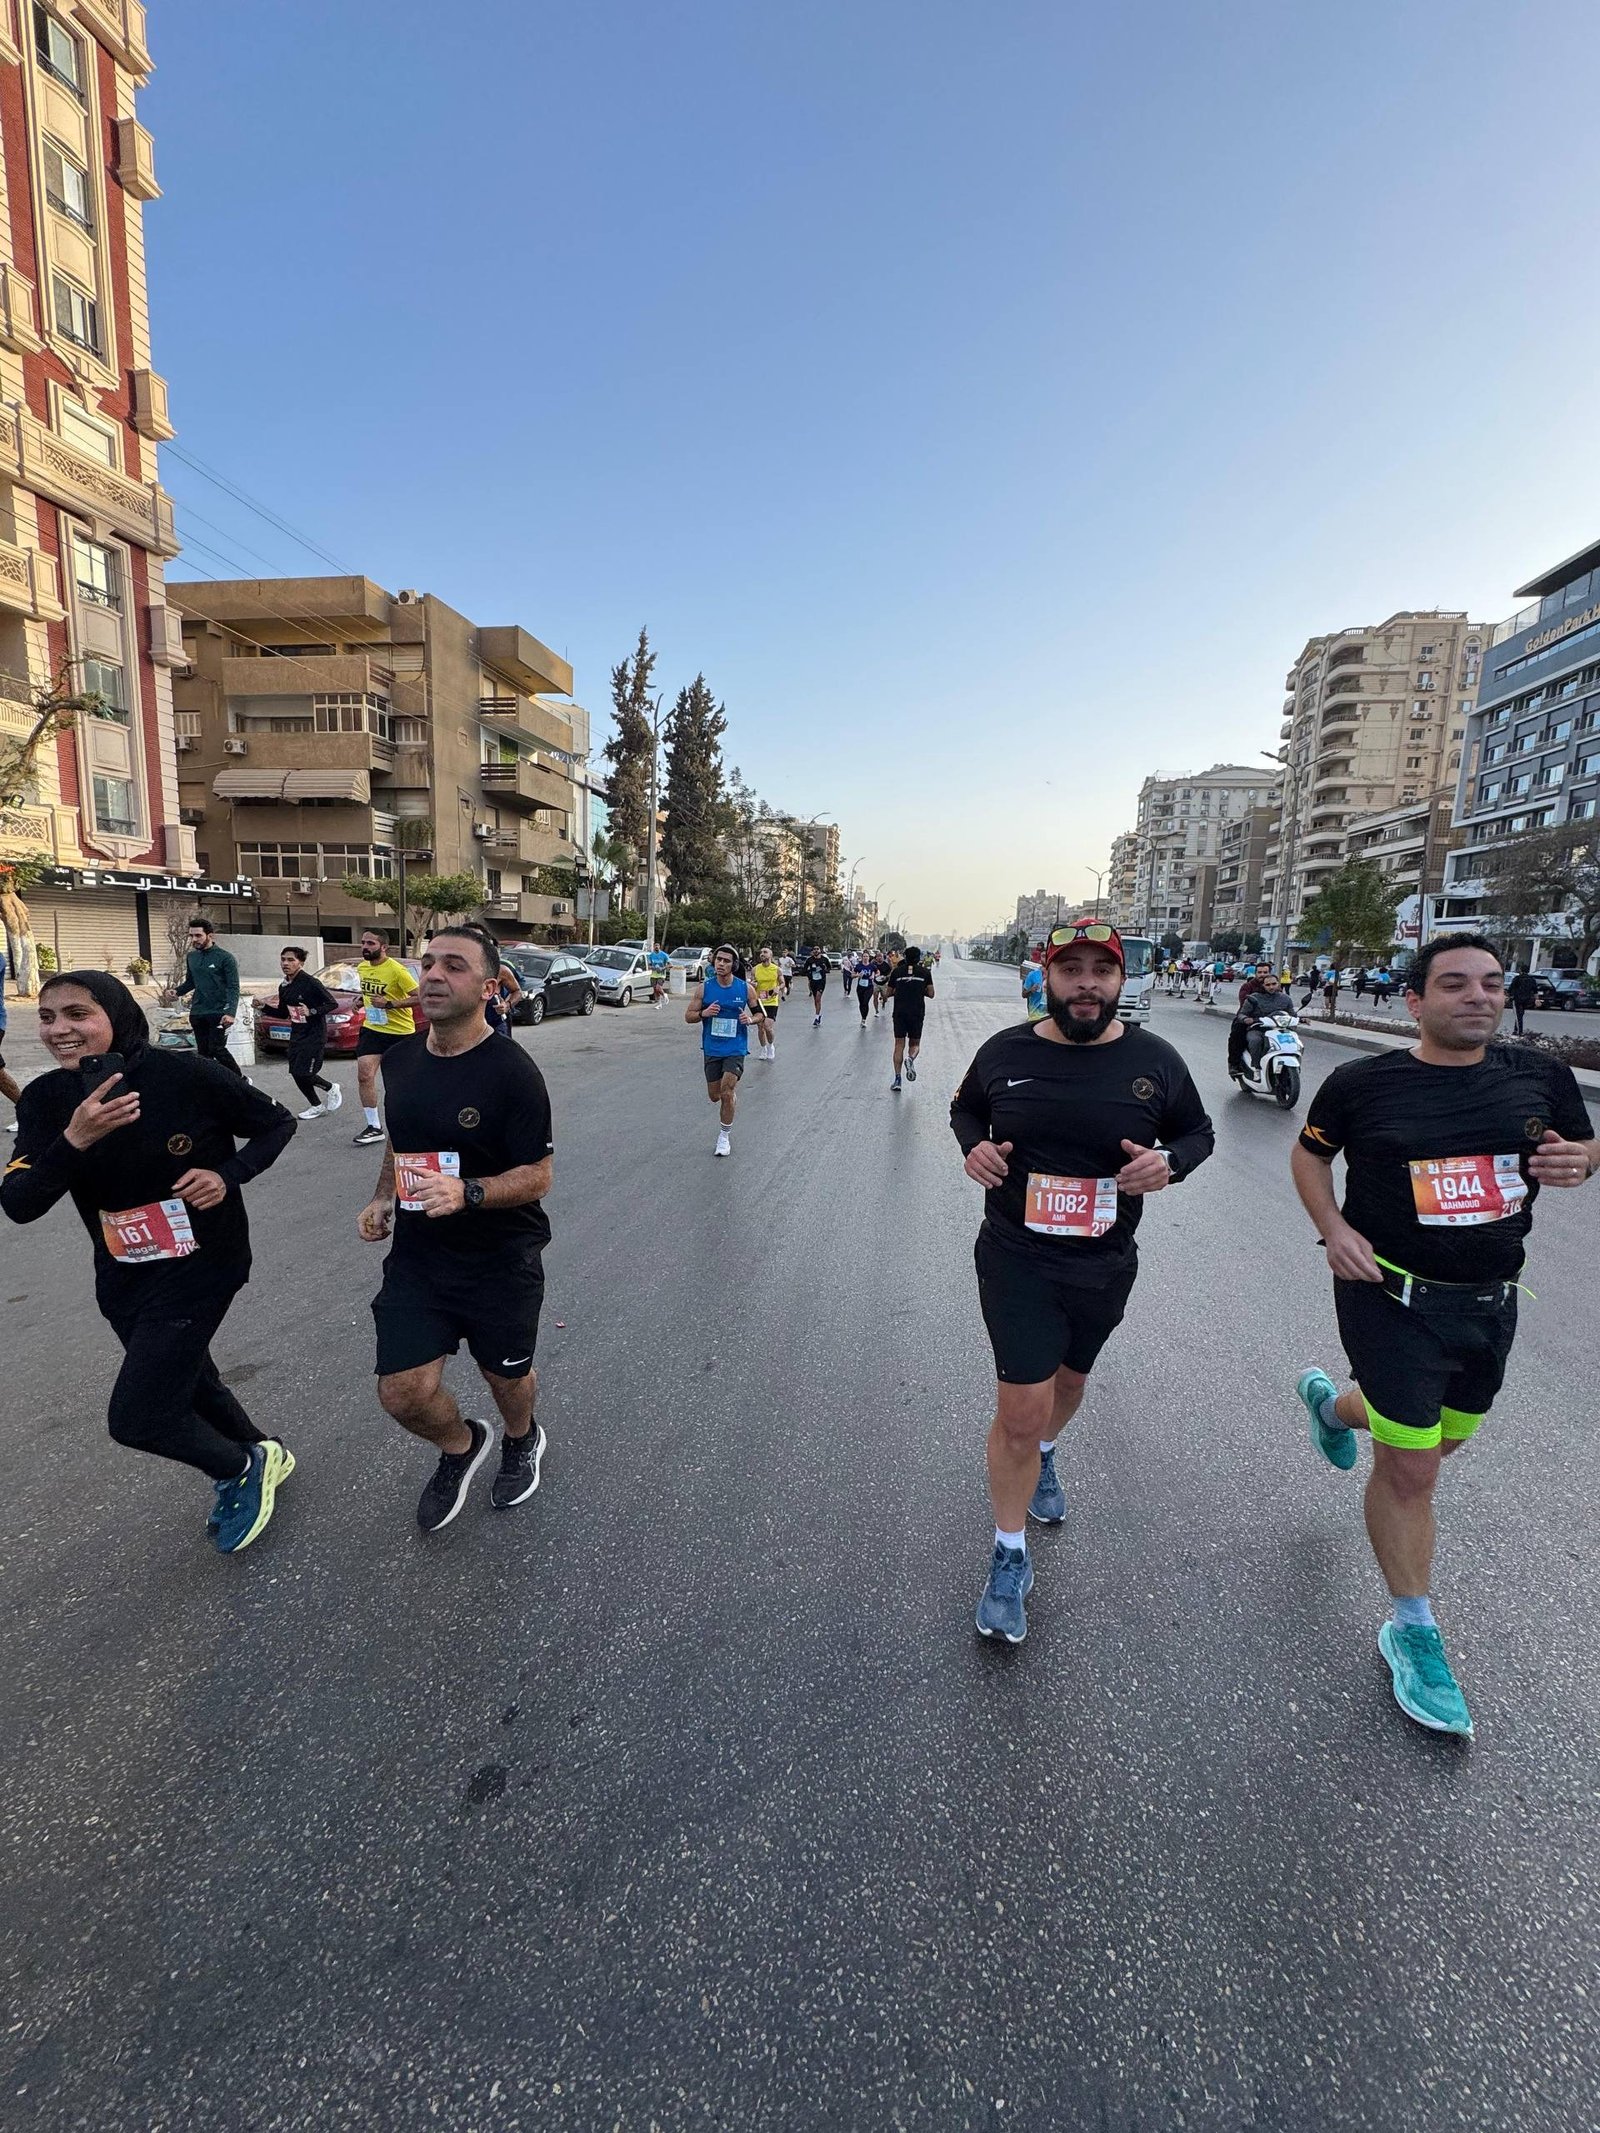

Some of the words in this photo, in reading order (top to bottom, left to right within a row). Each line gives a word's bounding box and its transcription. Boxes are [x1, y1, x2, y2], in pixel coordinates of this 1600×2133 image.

[1431, 1175, 1486, 1201] 1944
[1034, 1191, 1089, 1214] 11082
[1440, 1199, 1480, 1210] MAHMOUD
[1051, 1213, 1067, 1222] AMR
[117, 1222, 153, 1245] 161
[125, 1243, 159, 1256] Hagar
